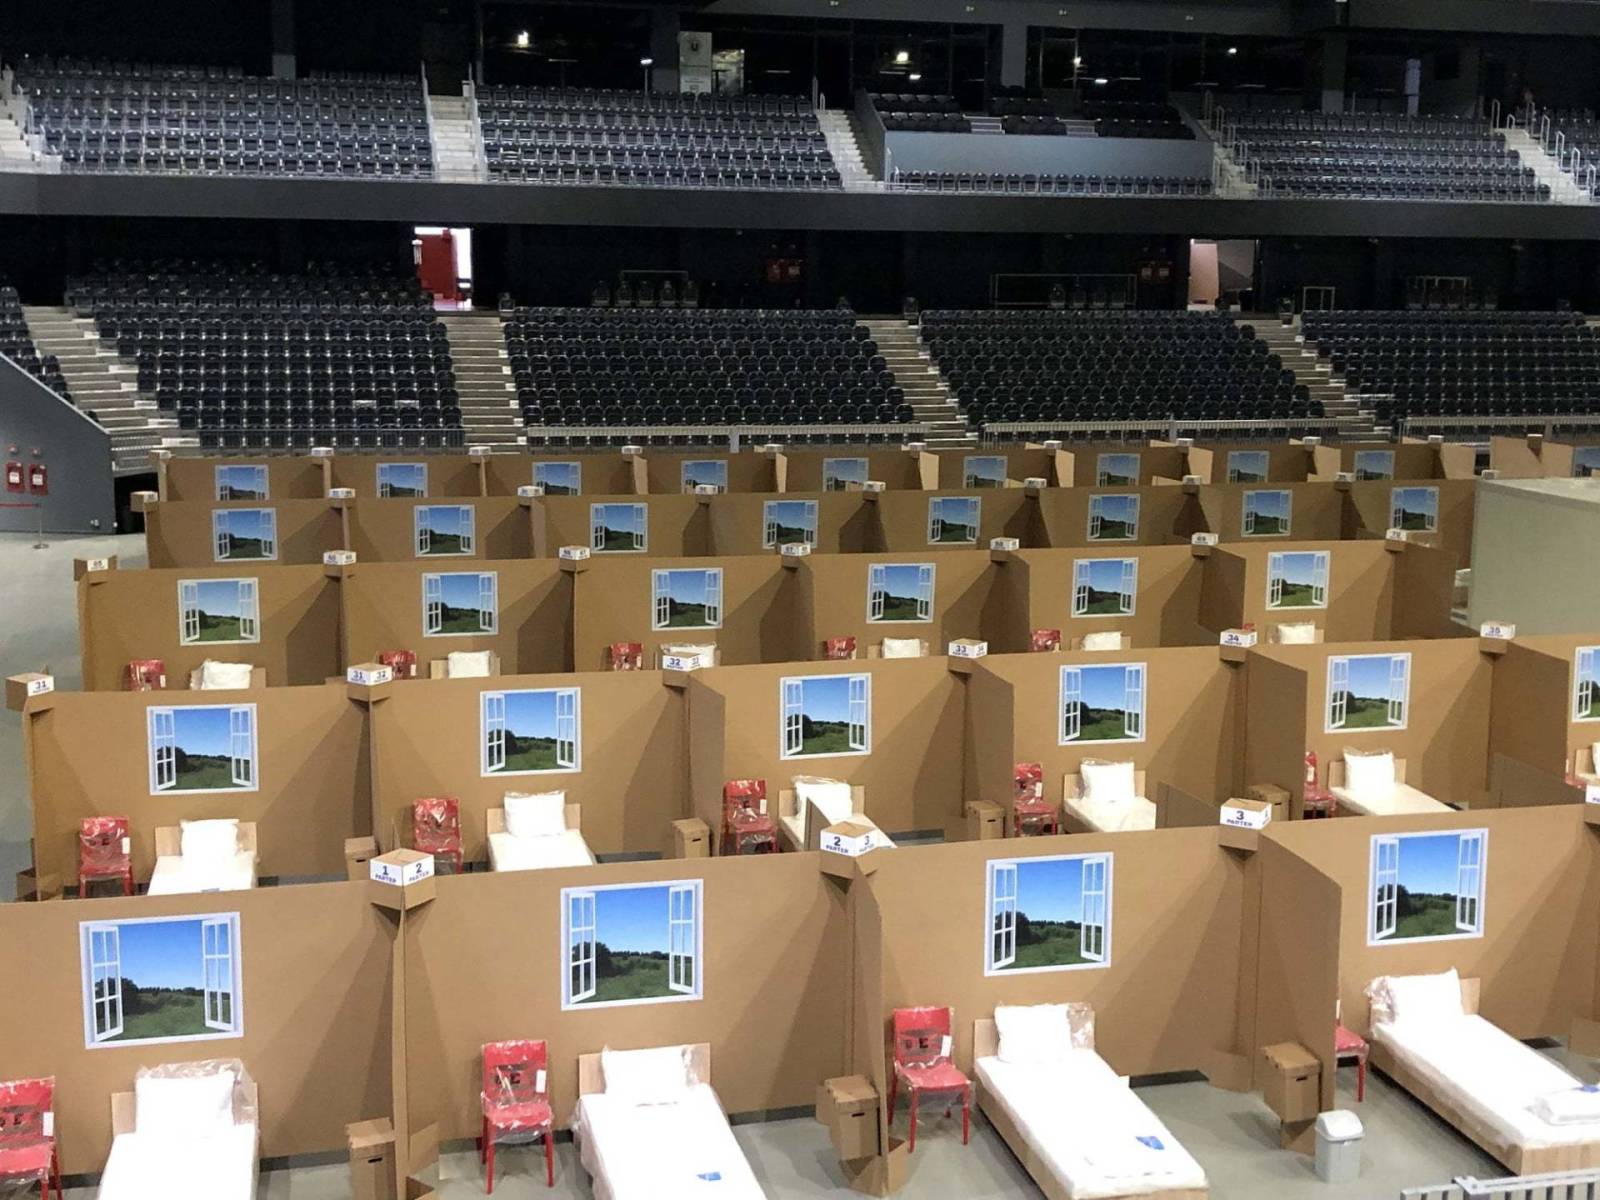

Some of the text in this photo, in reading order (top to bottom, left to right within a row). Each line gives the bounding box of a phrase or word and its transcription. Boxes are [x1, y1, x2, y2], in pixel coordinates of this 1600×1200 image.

[956, 645, 967, 653] 33
[670, 658, 681, 666] 32
[353, 670, 363, 680] 31
[35, 680, 46, 690] 31
[1236, 810, 1244, 820] 3
[834, 836, 841, 846] 2
[864, 835, 870, 846] 3
[382, 865, 389, 876] 1
[416, 863, 422, 874] 2
